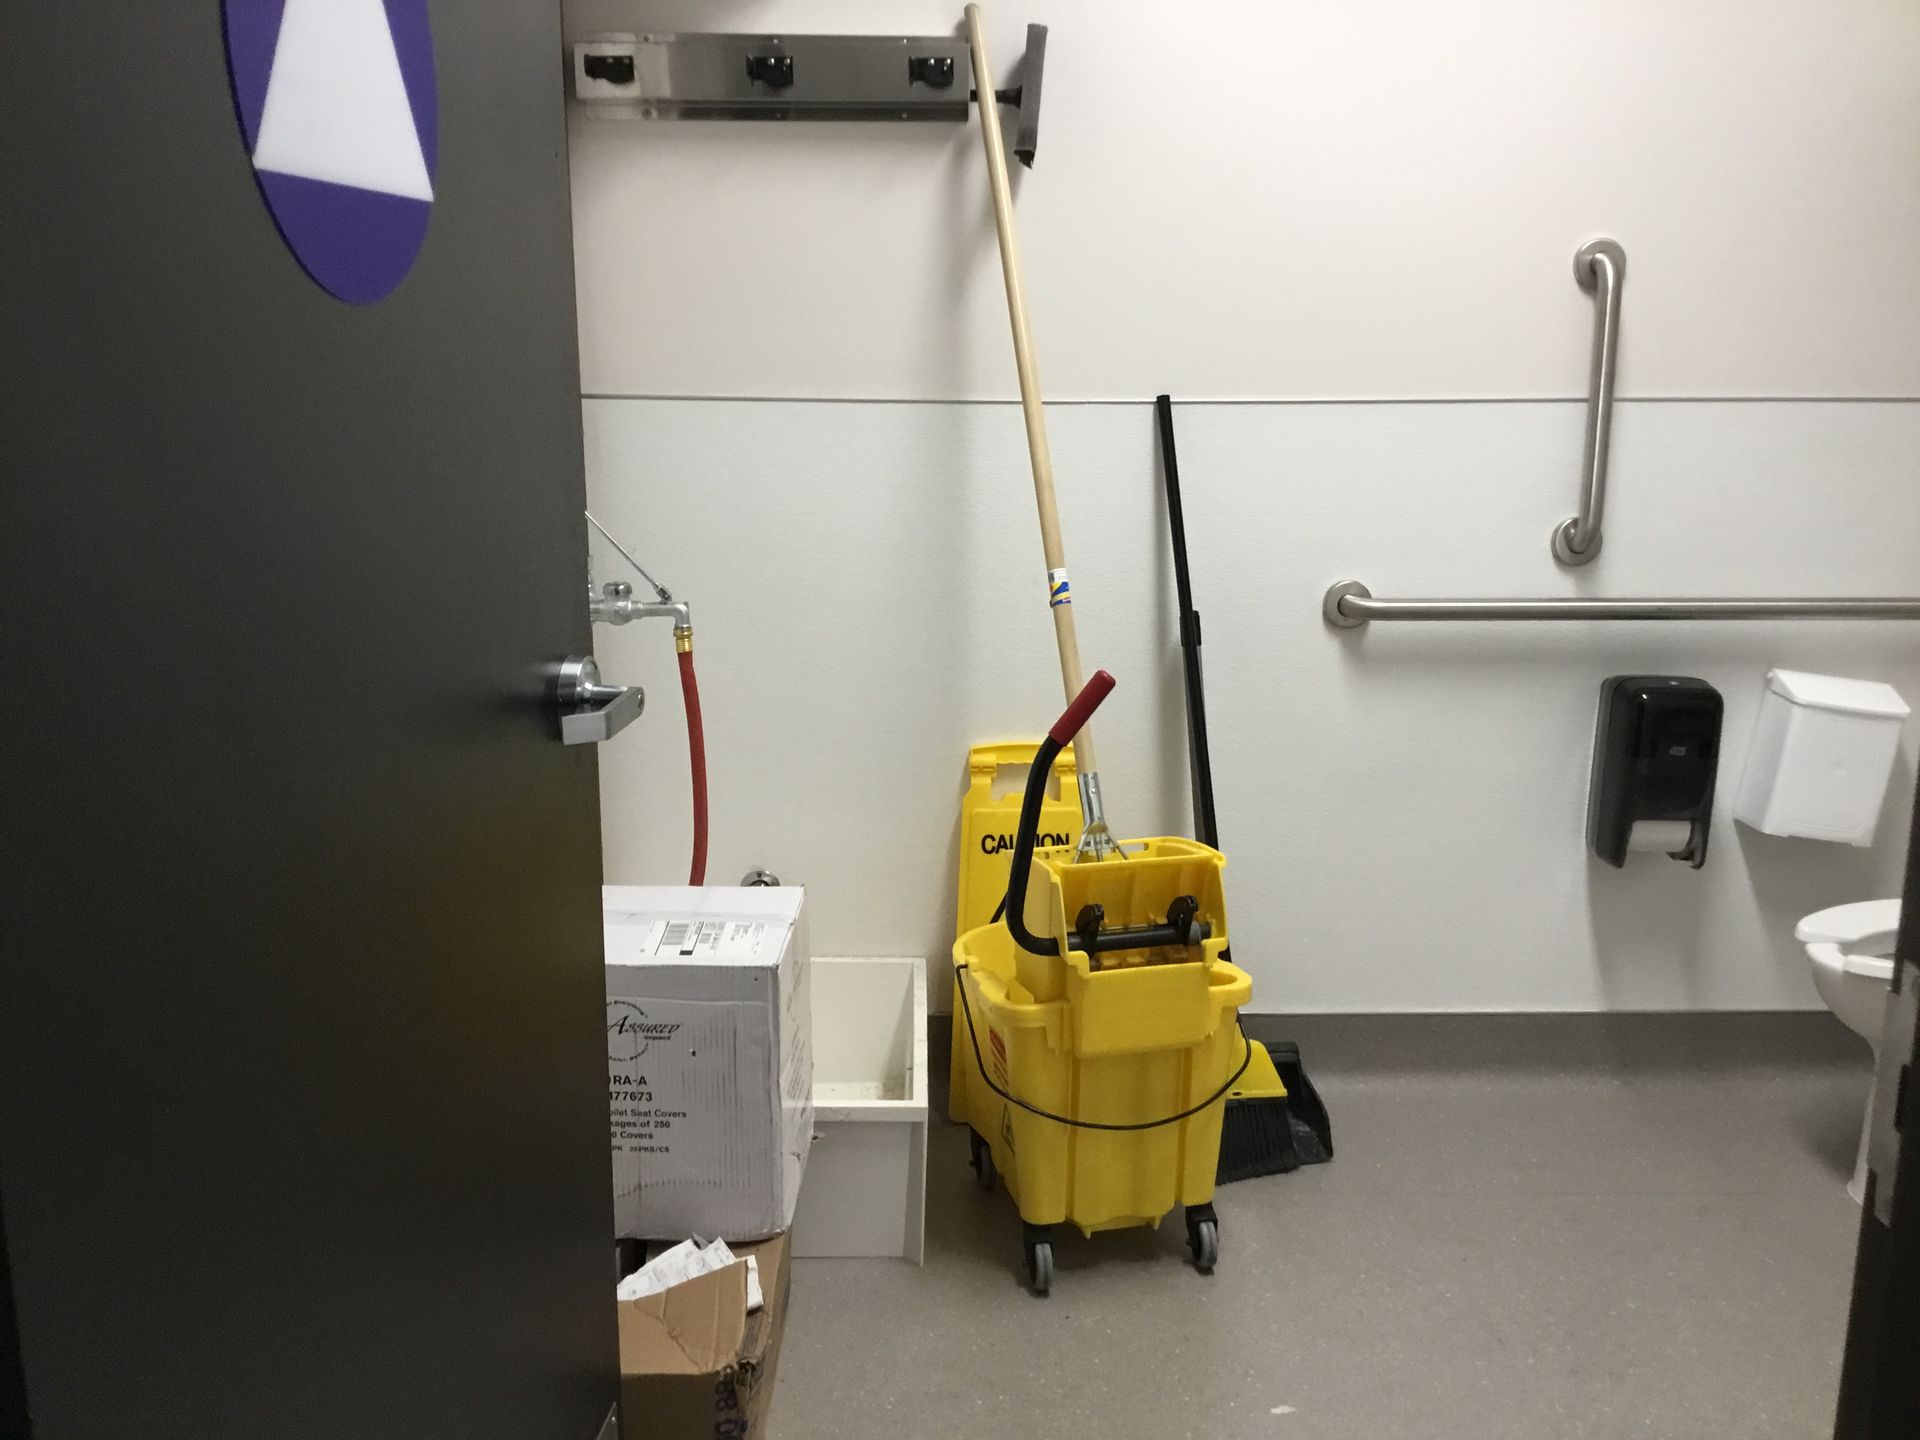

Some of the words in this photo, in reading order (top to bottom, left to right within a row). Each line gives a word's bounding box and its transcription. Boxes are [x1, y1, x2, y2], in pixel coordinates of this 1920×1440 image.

[981, 832, 1070, 854] CAION
[630, 1108, 652, 1118] Seat
[654, 1108, 687, 1118] Covers
[640, 1119, 651, 1128] of
[653, 1120, 671, 1129] 250
[619, 1130, 654, 1140] Covers
